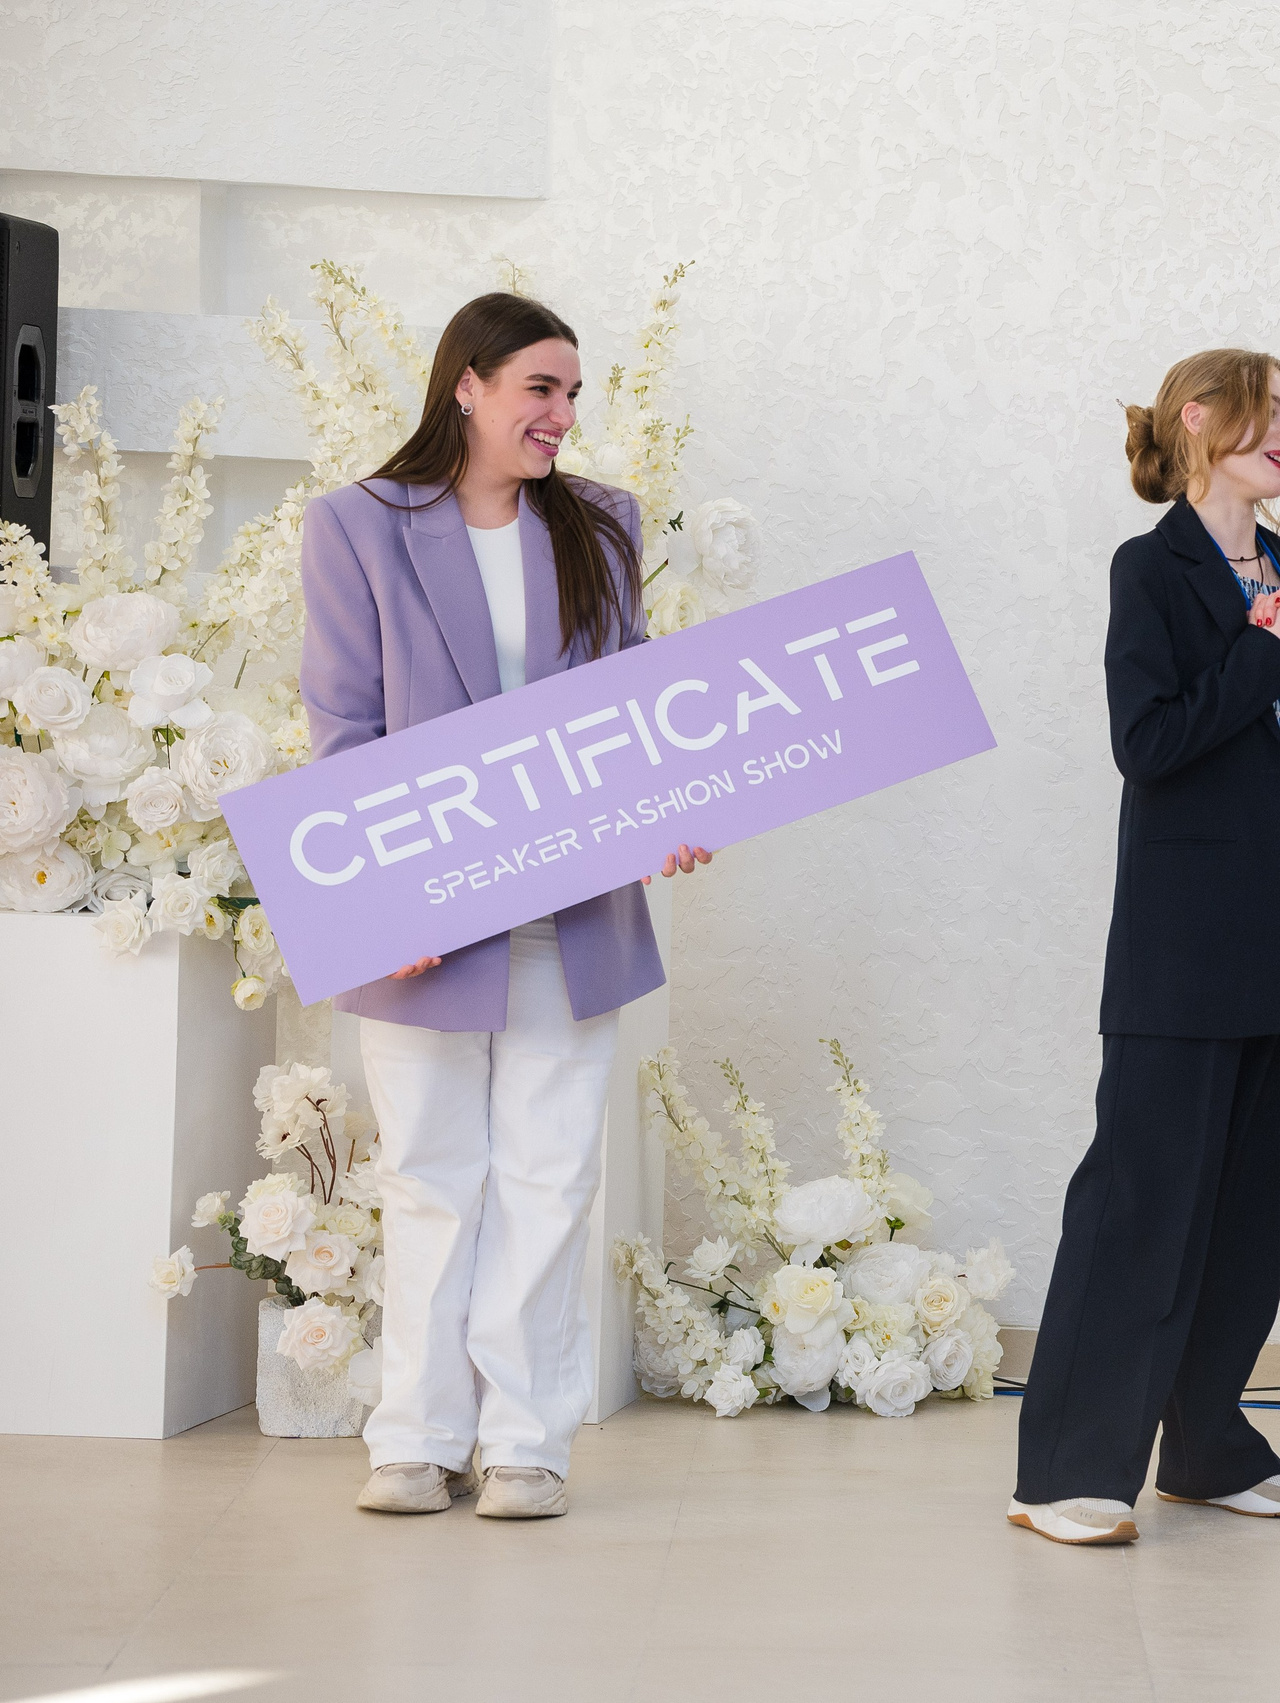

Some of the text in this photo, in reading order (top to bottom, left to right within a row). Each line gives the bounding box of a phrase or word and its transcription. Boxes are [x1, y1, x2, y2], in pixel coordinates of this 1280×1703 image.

[288, 606, 921, 887] CERTIFICATE
[423, 728, 844, 905] SPEAKER FASHION SHOW
